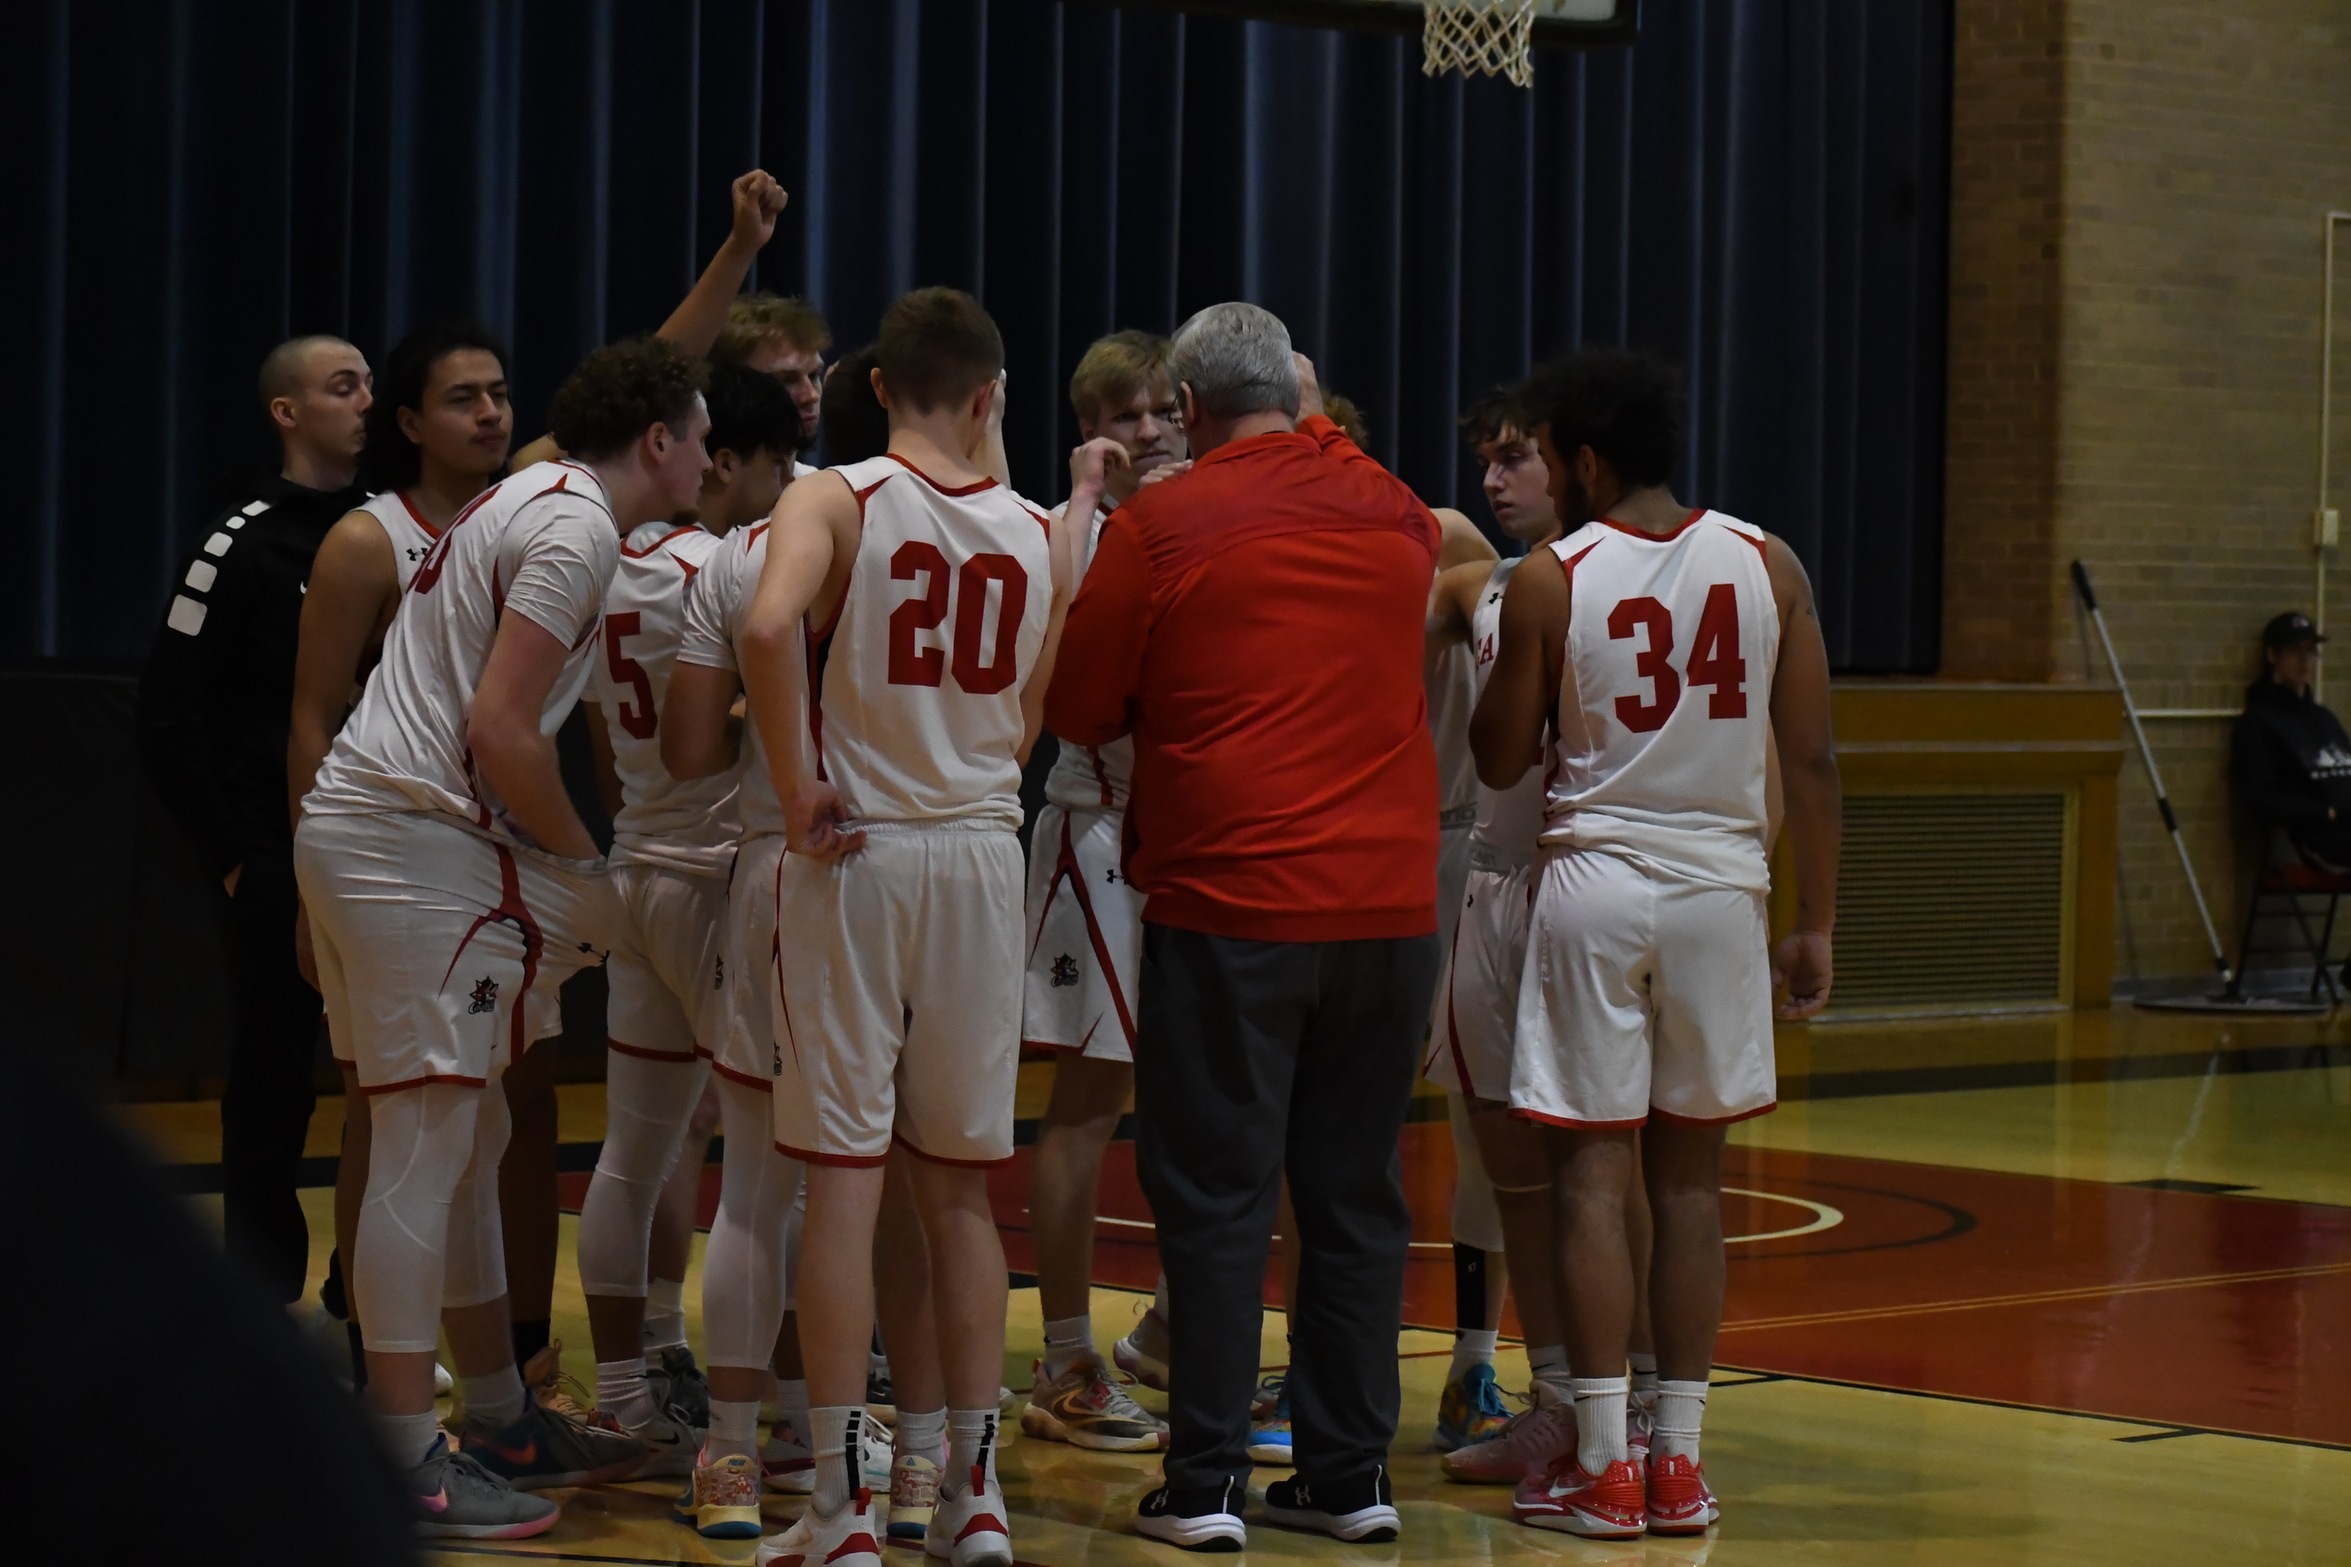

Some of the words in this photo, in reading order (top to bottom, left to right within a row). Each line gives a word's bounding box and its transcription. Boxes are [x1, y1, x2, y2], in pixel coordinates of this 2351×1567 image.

[605, 611, 658, 740] 5
[888, 541, 1028, 694] 20
[1607, 583, 1747, 733] 34
